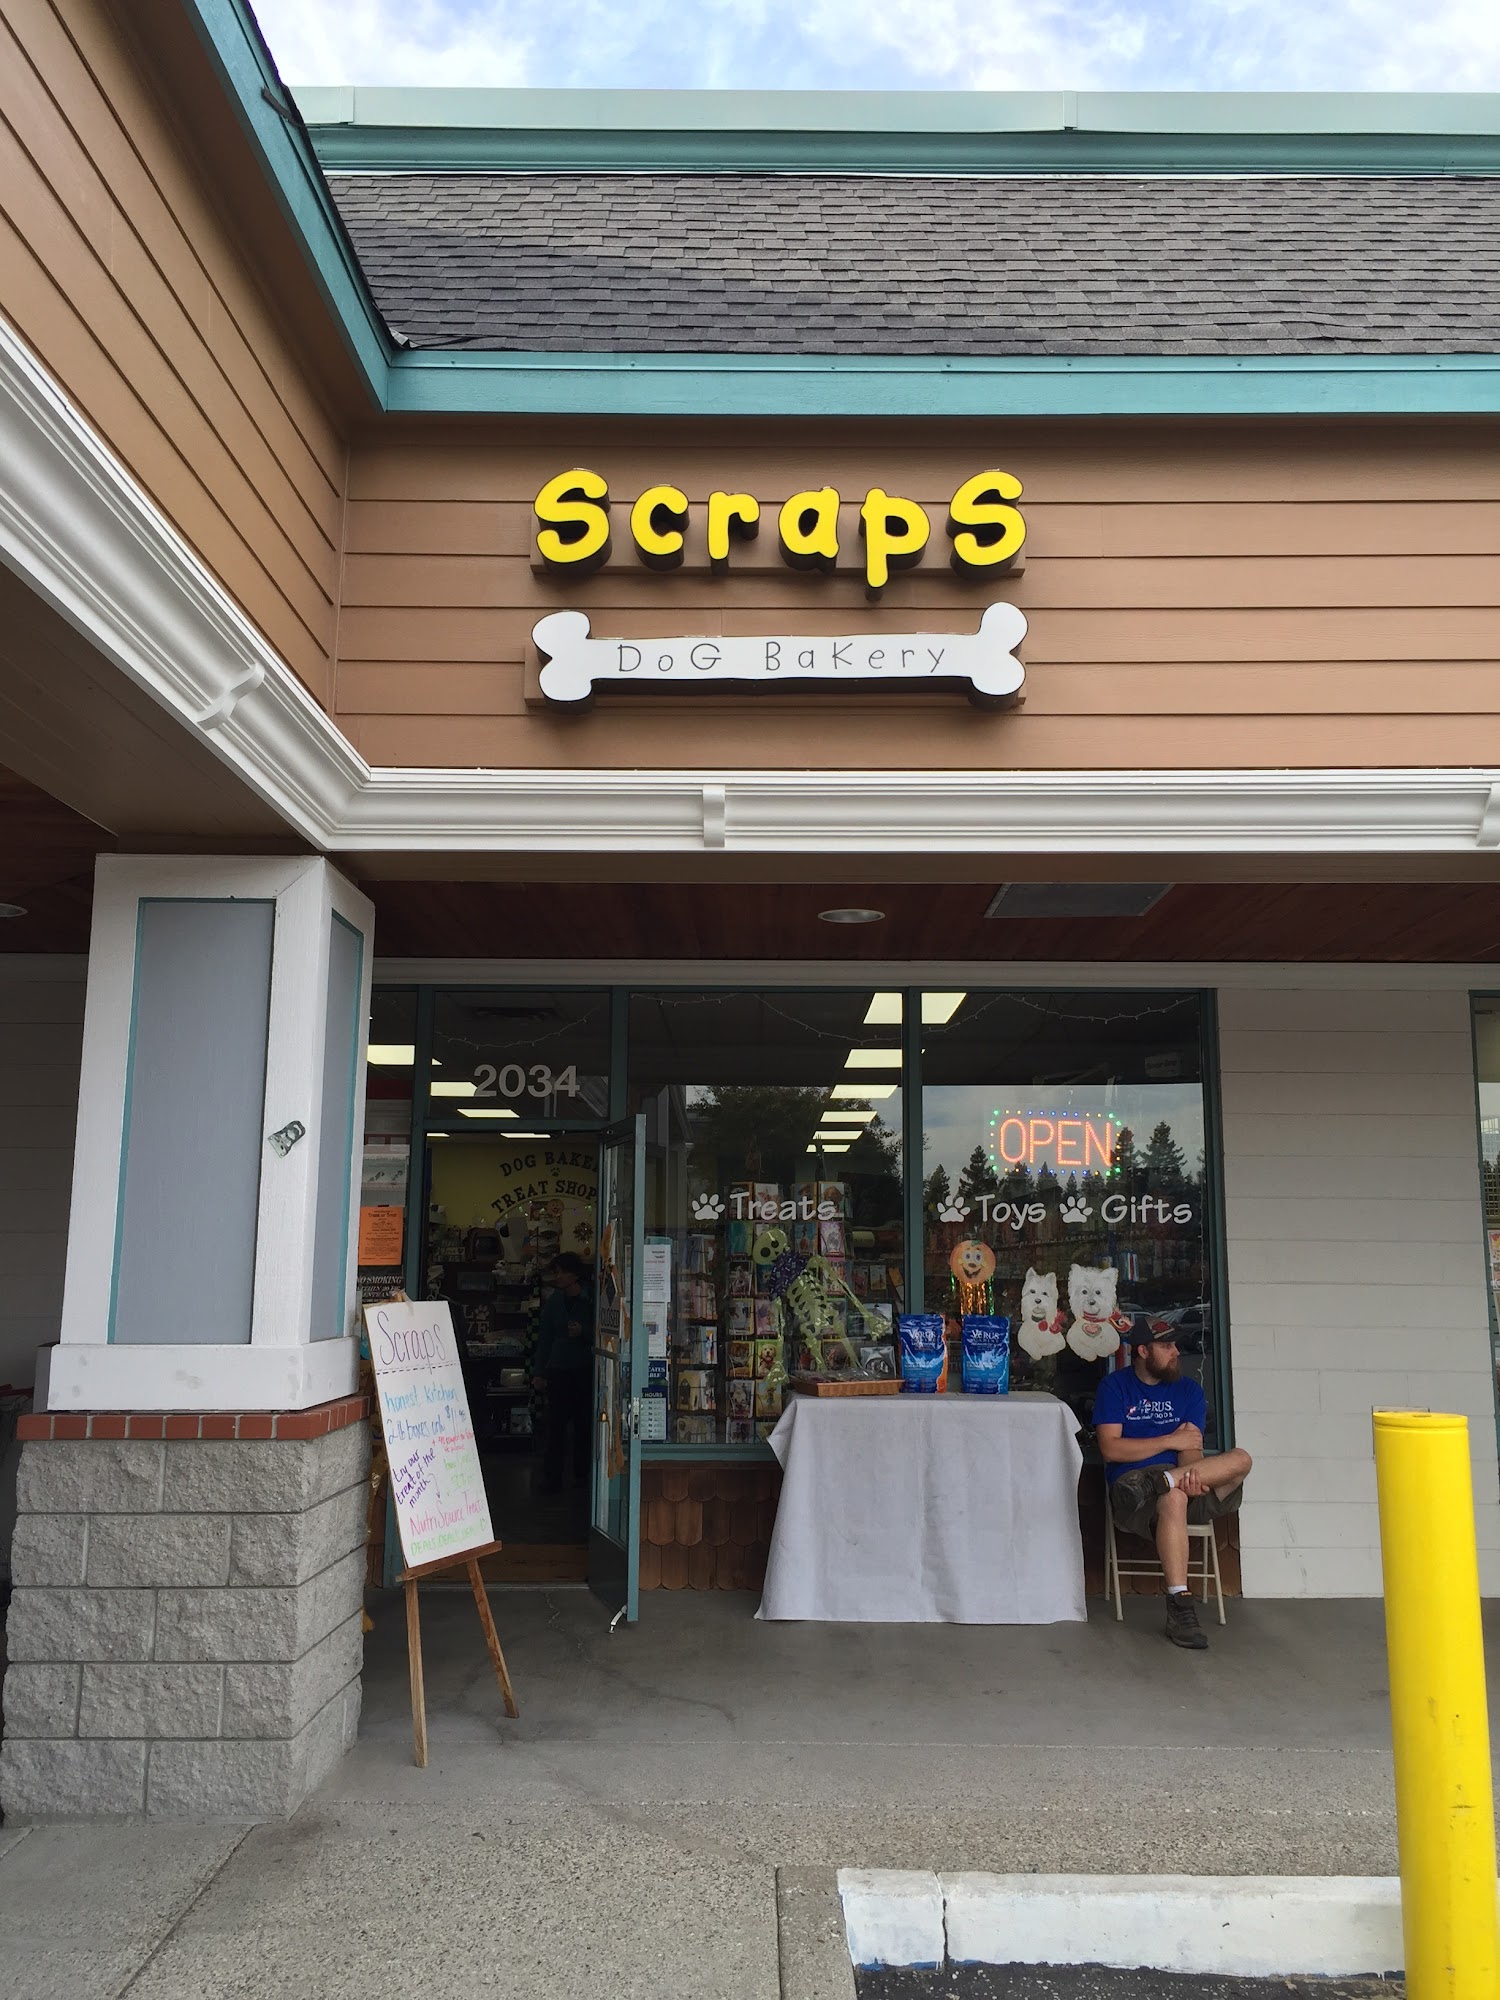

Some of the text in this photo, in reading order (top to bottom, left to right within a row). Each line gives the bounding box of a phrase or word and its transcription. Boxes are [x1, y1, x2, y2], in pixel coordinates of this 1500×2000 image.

[473, 1064, 581, 1098] 2034
[1000, 1118, 1113, 1167] OPEN
[500, 1152, 598, 1177] DOG BAKE
[491, 1180, 598, 1213] TREAT SHOP
[729, 1191, 838, 1221] Treats
[975, 1194, 1193, 1230] Toys Gifts
[366, 1275, 402, 1284] SMOKING
[377, 1311, 446, 1374] Scraps
[392, 1448, 421, 1483] try our
[396, 1474, 417, 1505] treat
[423, 1447, 436, 1467] the
[409, 1478, 431, 1509] month
